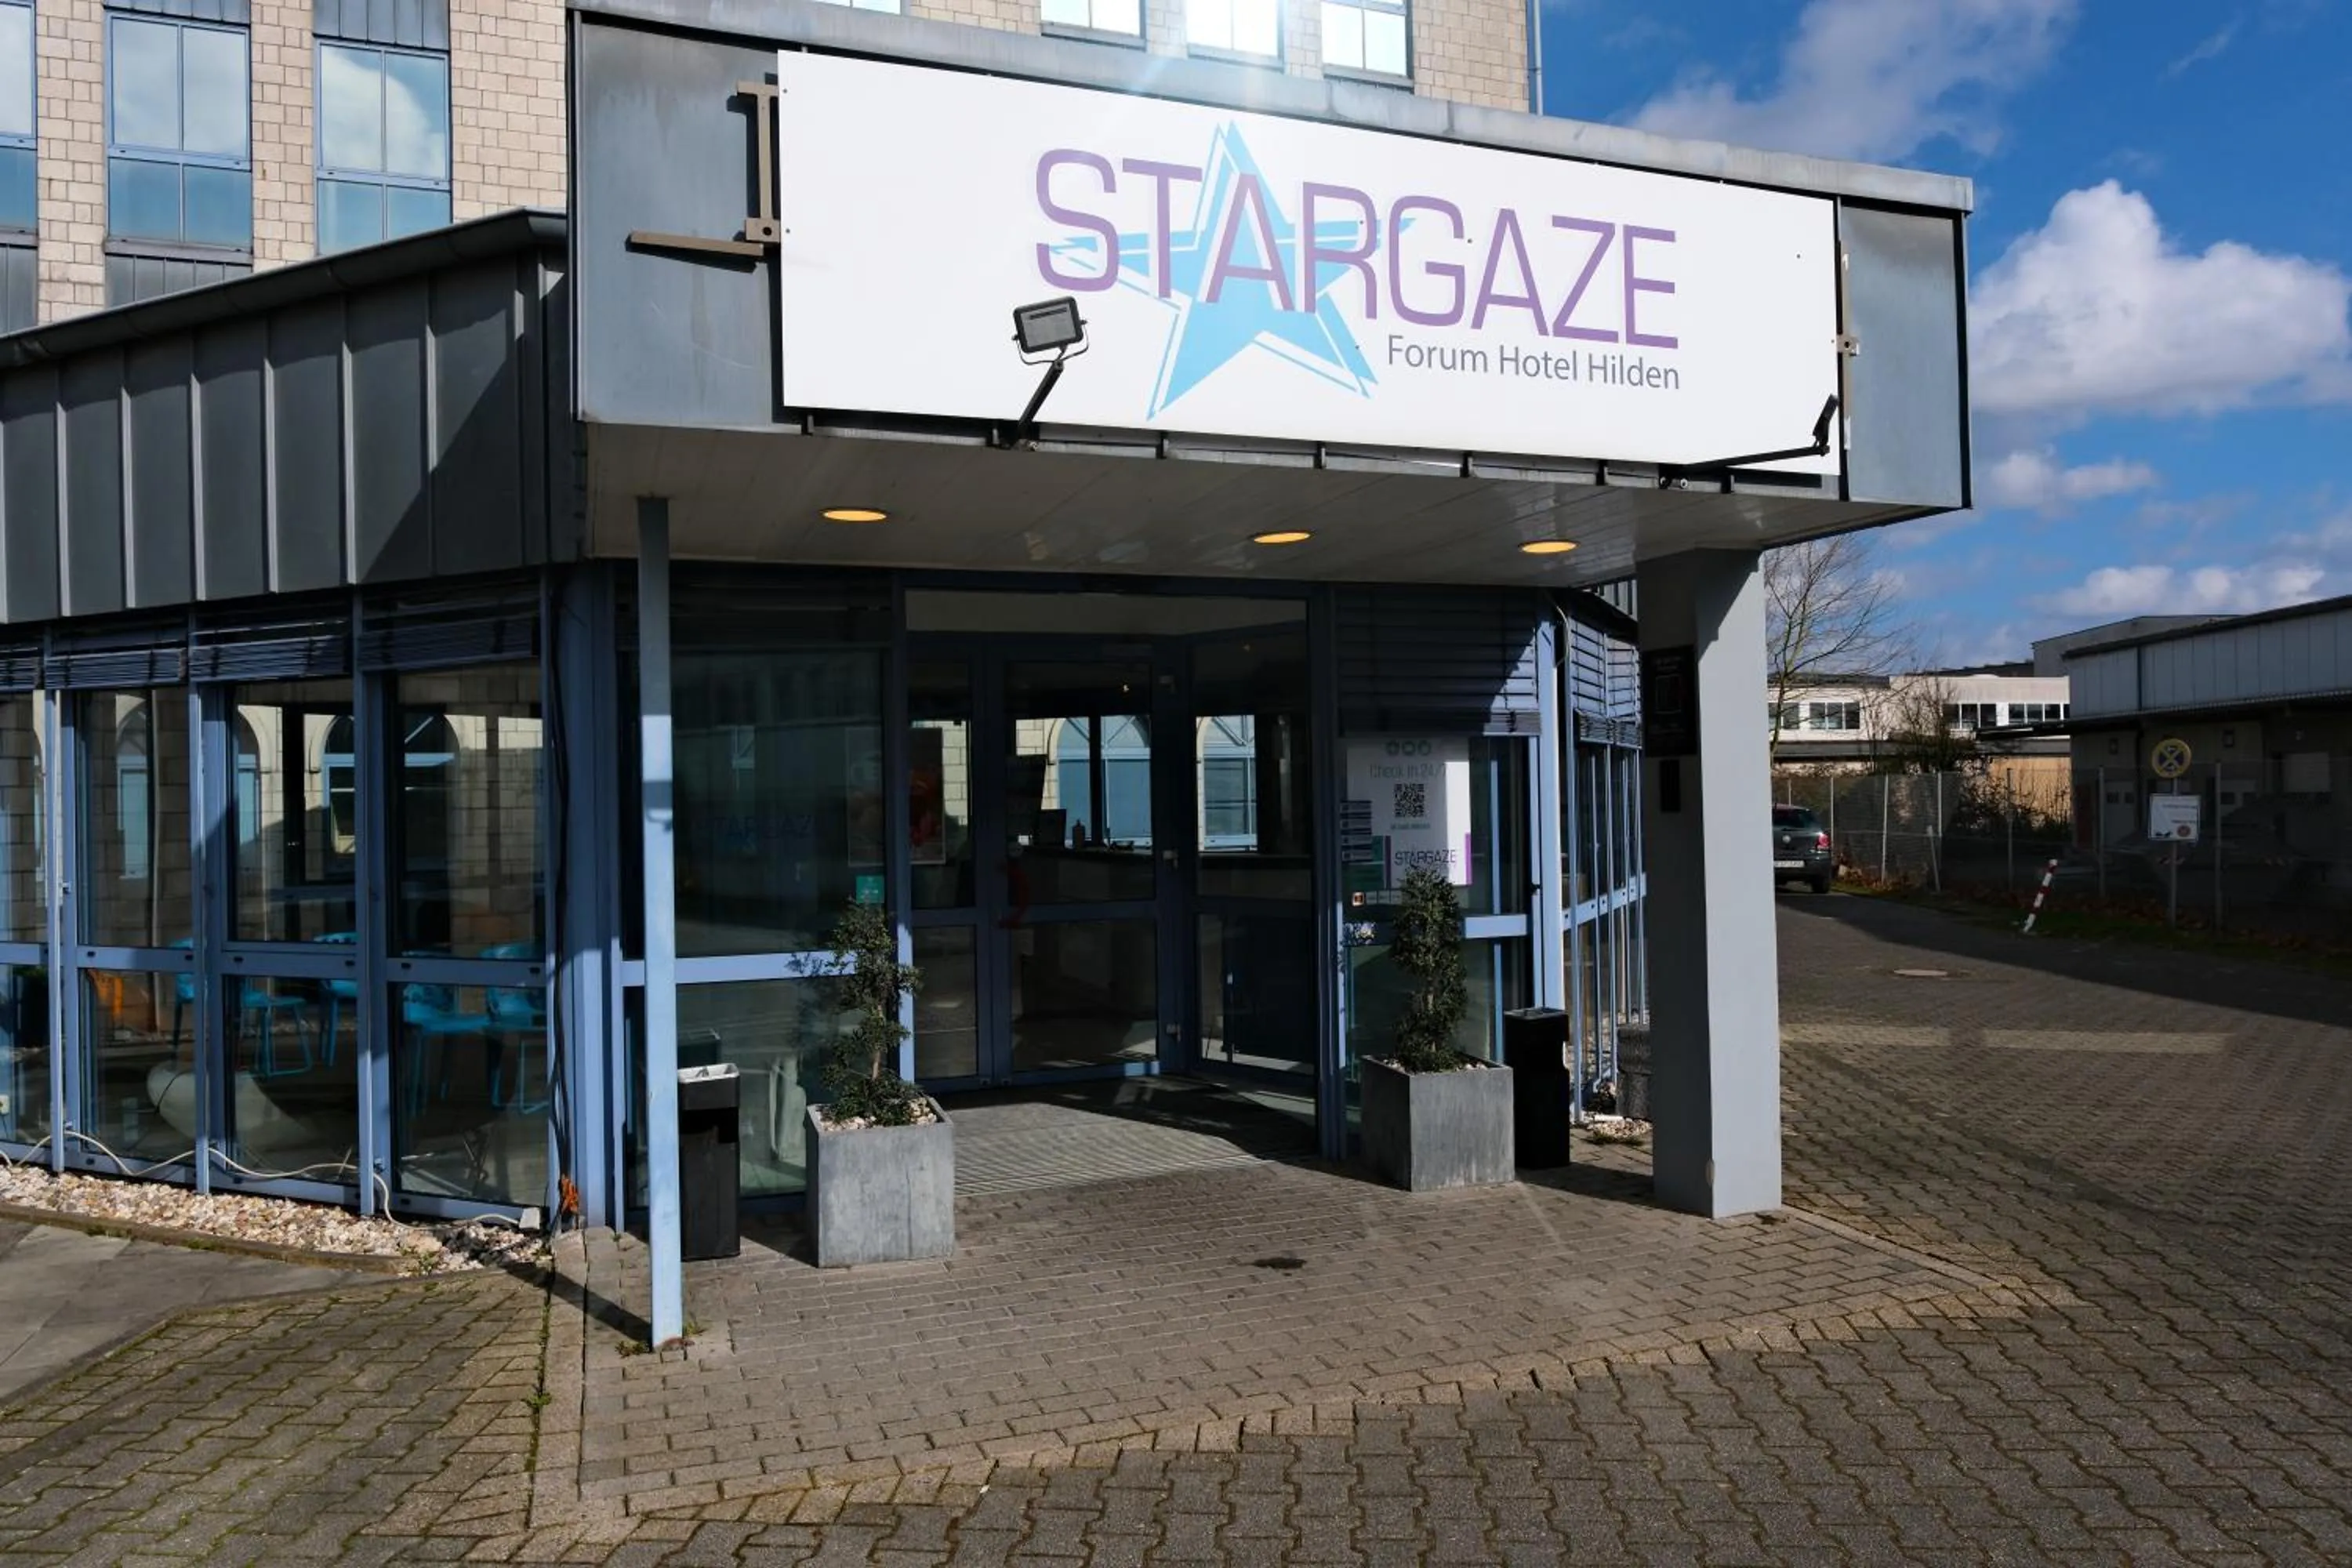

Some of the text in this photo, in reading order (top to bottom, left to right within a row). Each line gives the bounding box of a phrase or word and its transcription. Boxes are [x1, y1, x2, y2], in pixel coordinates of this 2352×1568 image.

[1036, 148, 1679, 350] STARGAZE
[1388, 335, 1680, 390] Forum Hotel Hilden
[1395, 849, 1456, 866] STARGAZE
